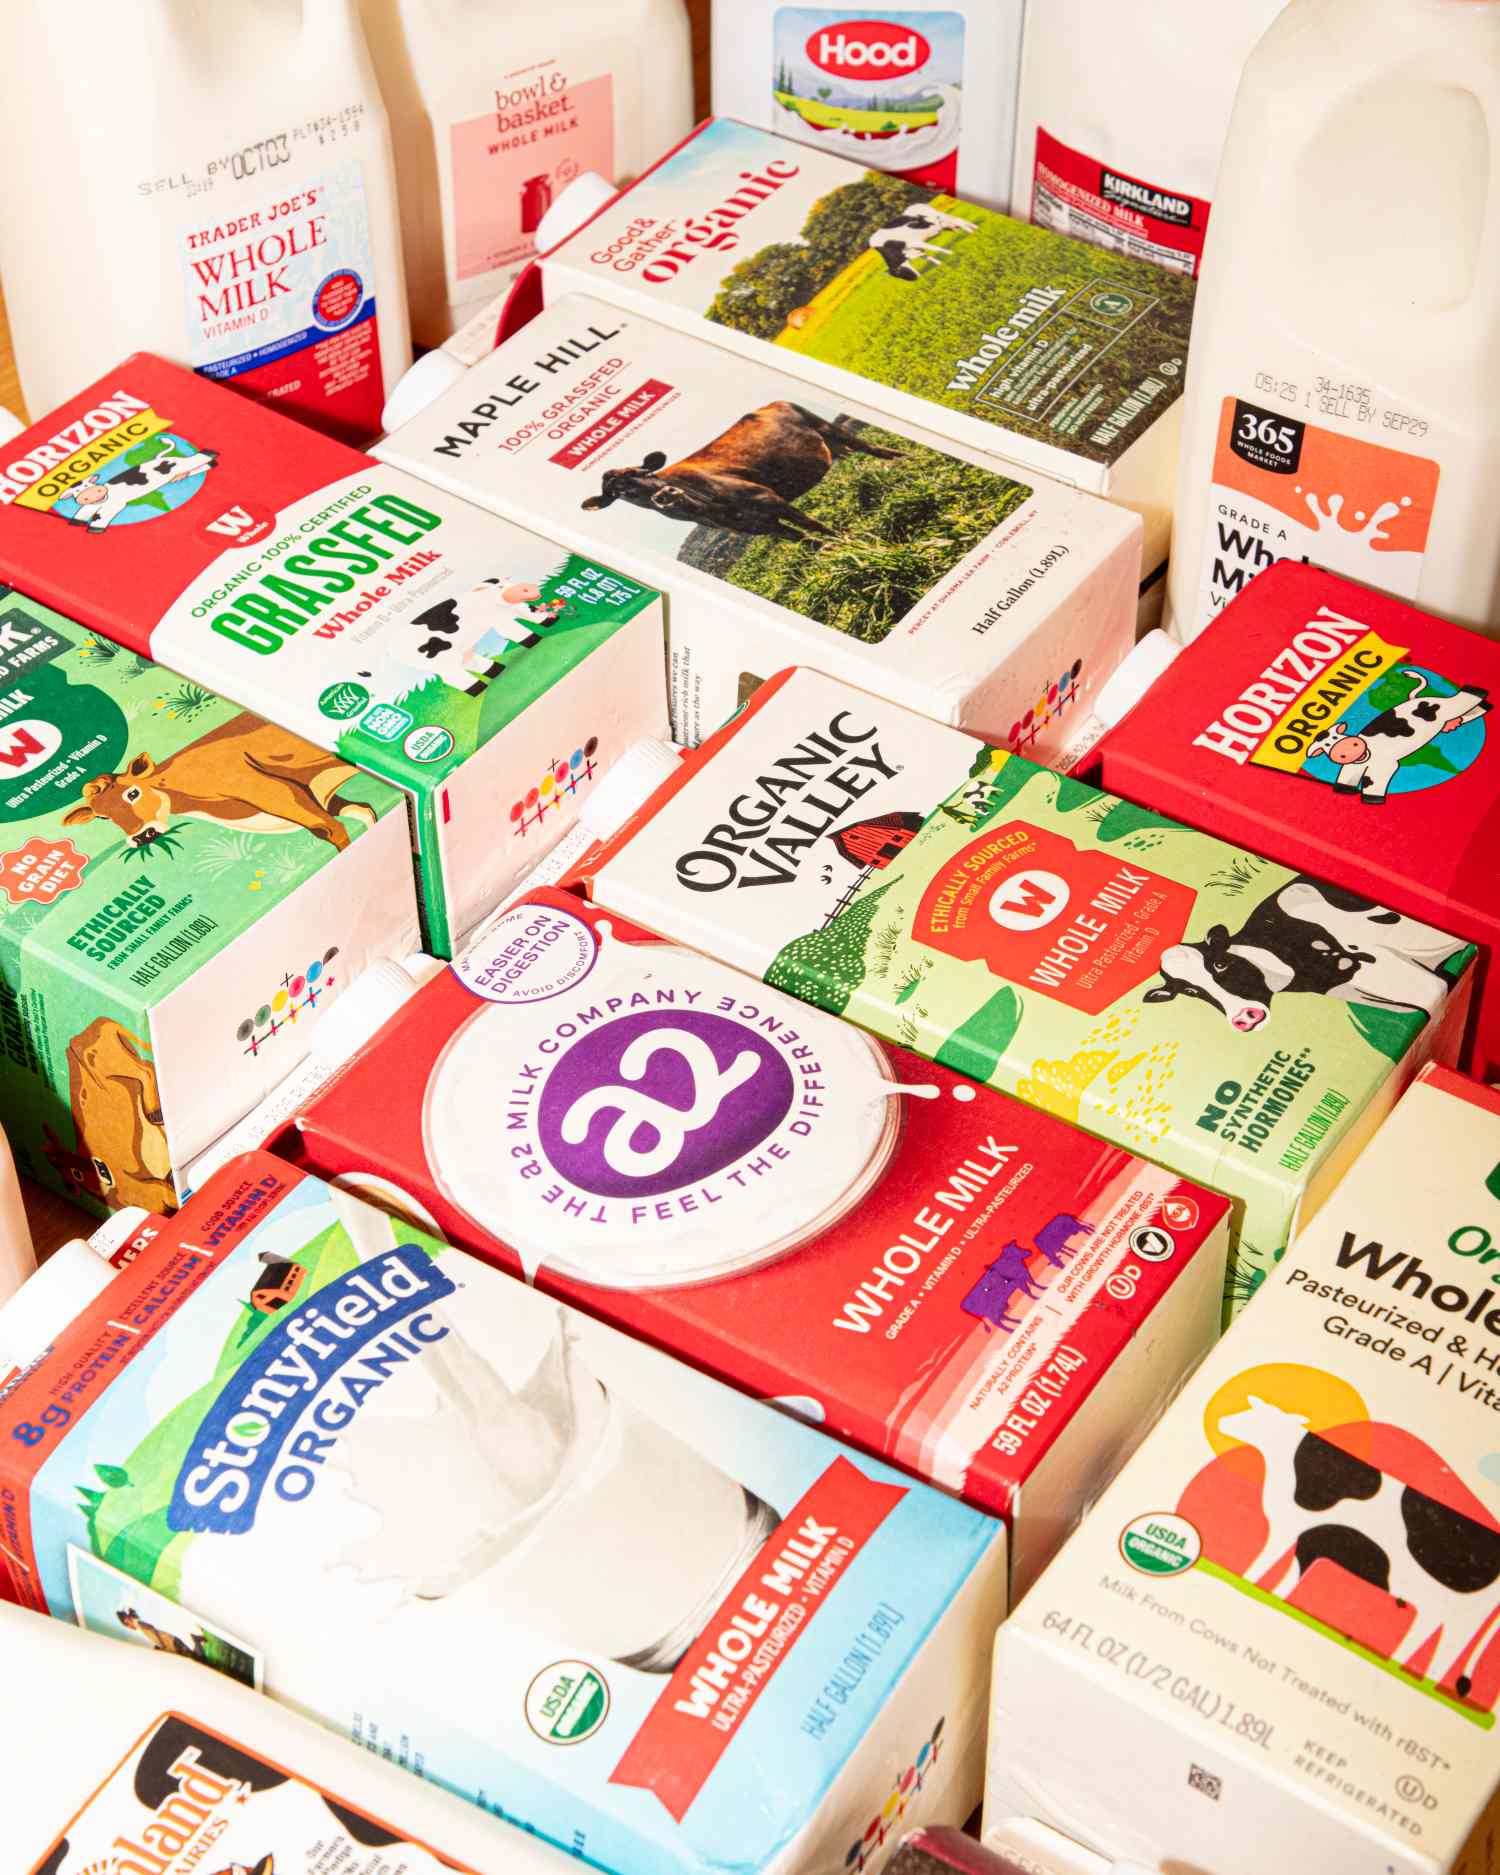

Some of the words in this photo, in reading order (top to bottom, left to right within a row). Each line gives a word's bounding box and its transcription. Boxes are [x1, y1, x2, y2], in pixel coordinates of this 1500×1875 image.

[819, 34, 916, 66] Hood
[496, 75, 547, 111] bowl
[497, 96, 571, 133] basket
[488, 130, 538, 155] WHOLE
[544, 117, 579, 138] MILK
[187, 212, 262, 249] TRADER
[267, 189, 318, 221] JOE'S
[641, 159, 800, 283] organic
[1103, 173, 1191, 216] KIRKLAND
[1112, 207, 1146, 228] MILK
[191, 215, 328, 288] WHOLE
[591, 225, 645, 265] Good
[612, 221, 677, 272] Gather
[198, 265, 291, 322] MILK
[203, 312, 257, 339] VITAMIN
[260, 308, 269, 321] D
[946, 326, 1020, 391] whole
[1009, 284, 1067, 330] milk
[433, 374, 541, 458] MAPLE
[533, 325, 620, 374] HILL
[498, 419, 545, 452] 100%
[541, 357, 624, 420] GRASSFED
[547, 384, 622, 441] ORGANIC
[1089, 421, 1120, 446] HALF
[1107, 396, 1146, 428] GALLON
[1319, 394, 1349, 419] SELL
[1357, 401, 1377, 423] BY
[1381, 410, 1430, 438] SEP29
[567, 415, 623, 458] WHOLE
[619, 390, 657, 420] MILK
[1236, 439, 1264, 456] WHOLE
[1265, 448, 1292, 465] FOODS
[1237, 413, 1297, 455] 365
[36, 422, 149, 499] ORGANIC
[1247, 451, 1279, 468] MARKET
[190, 560, 263, 618] ORGANIC
[261, 533, 302, 562] 100%
[299, 484, 373, 534] CERTIFIED
[1217, 503, 1271, 535] GRADE
[1277, 529, 1288, 541] A
[210, 494, 443, 656] GRASSFED
[311, 584, 392, 641] Whole
[383, 549, 443, 586] Milk
[972, 606, 1001, 636] Half
[996, 578, 1037, 612] Gallon
[1029, 543, 1071, 580] (1.89L)
[8, 635, 59, 668] FARMS
[1191, 605, 1371, 767] HORIZON
[1273, 649, 1384, 755] ORGANIC
[23, 760, 70, 798] Pasteurized
[67, 738, 100, 762] Vitamin
[410, 730, 436, 752] USDA
[54, 768, 81, 789] Grade
[675, 710, 878, 893] ORGANIC
[736, 742, 899, 889] VALLEY
[10, 854, 38, 876] NO
[18, 849, 65, 893] GRAIN
[38, 860, 76, 894] DIET
[930, 870, 971, 934] ETHICALLY
[963, 831, 1030, 872] SOURCED
[959, 880, 982, 908] Small
[975, 857, 1007, 888] Family
[66, 874, 157, 951] ETHICALLY
[86, 893, 167, 962] SOURCED
[952, 906, 969, 929] from
[999, 878, 1057, 918] W
[1028, 912, 1109, 988] WHOLE
[1090, 867, 1150, 916] MILK
[107, 951, 130, 971] FROM
[127, 931, 152, 954] SMALL
[148, 911, 173, 936] FAMILY
[129, 957, 162, 988] HALF
[155, 933, 195, 969] GALLON
[182, 913, 219, 945] (1.89L)
[474, 937, 529, 987] EASIER
[524, 914, 552, 937] ON
[490, 920, 571, 994] DIGESTION
[512, 983, 554, 997] AVOID
[556, 930, 589, 986] DISCOMFORT
[1076, 960, 1105, 990] Ultra
[1094, 920, 1140, 972] Pasteurized
[1133, 898, 1156, 922] Grade
[1120, 933, 1154, 965] Vitamin
[538, 988, 703, 1055] COMPANY
[716, 995, 826, 1137] DIFFERENCE
[1220, 1049, 1292, 1143] SYNTHETIC
[506, 1063, 544, 1131] MILK
[560, 1027, 762, 1178] a2
[1195, 1079, 1243, 1134] NO
[1293, 1104, 1334, 1150] GALLON
[727, 1142, 791, 1188] THE
[1278, 1142, 1310, 1172] HALF
[204, 1188, 266, 1248] VITAMIN
[541, 1184, 608, 1225] THE
[631, 1187, 724, 1225] FEEL
[832, 1205, 955, 1334] WHOLE
[933, 1135, 1020, 1213] MILK
[885, 1304, 917, 1340] GRADE
[921, 1251, 958, 1292] VITAMIN
[963, 1162, 1034, 1241] ULTRA-PASTEURIZED
[1056, 1274, 1075, 1295] OUR
[1071, 1250, 1094, 1279] COWS
[1103, 1218, 1120, 1239] NOT
[1114, 1190, 1143, 1223] TREATED
[132, 1255, 203, 1326] CALCIUM
[1066, 1283, 1085, 1304] WITH
[1080, 1254, 1108, 1288] GROWTH
[1285, 1268, 1445, 1344] Pasteurized
[1446, 1334, 1469, 1358] &
[61, 1333, 131, 1405] PROTEIN
[969, 1360, 1009, 1411] NATURALLY
[1006, 1315, 1044, 1361] CONTAINS
[1034, 1344, 1088, 1398] (1.74L)
[1323, 1315, 1407, 1362] Grade
[1409, 1354, 1433, 1376] A
[183, 1255, 431, 1514] Stonyfield
[274, 1313, 450, 1502] ORGANIC
[1020, 1388, 1053, 1420] OZ
[991, 1426, 1023, 1457] 59
[1007, 1408, 1038, 1434] FL
[1145, 1522, 1187, 1550] USDA
[673, 1592, 781, 1720] WHOLE
[760, 1515, 838, 1597] MILK
[711, 1601, 808, 1733] ULTRA-PASTEURIZED
[801, 1544, 850, 1596] VITAMIN
[1042, 1610, 1072, 1636] 64
[1070, 1622, 1095, 1650] FL
[1096, 1636, 1129, 1666] OZ
[1125, 1650, 1173, 1691] (1/2
[1169, 1675, 1222, 1720] GAL)
[1218, 1703, 1276, 1751] 1.89L
[1099, 1574, 1139, 1602] Milk
[1140, 1591, 1186, 1626] From
[1189, 1618, 1240, 1653] Cows
[1242, 1646, 1277, 1674] Not
[1281, 1666, 1351, 1716] Treated
[1353, 1711, 1393, 1742] with
[539, 1674, 576, 1720] USDA
[800, 1698, 838, 1742] HALF
[822, 1648, 874, 1706] GALLON
[1303, 1739, 1348, 1769] KEEP
[1292, 1754, 1423, 1837] REFRIGERATED
